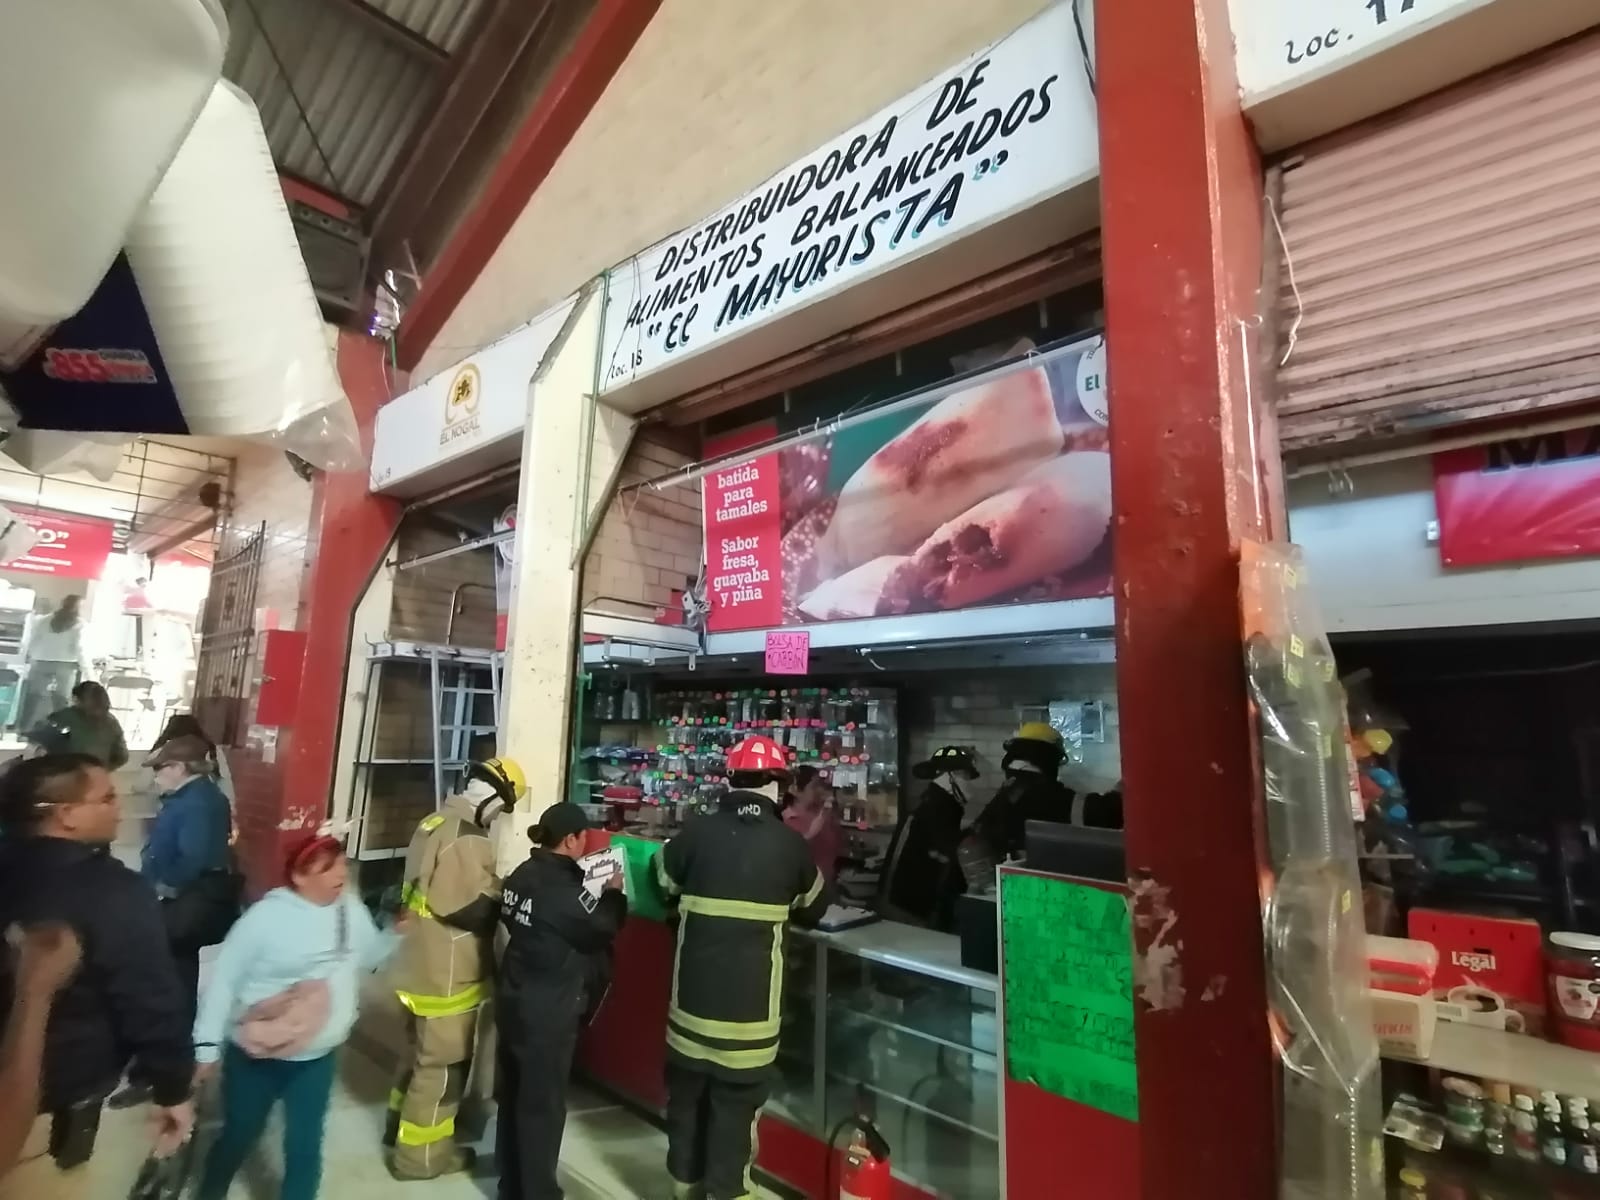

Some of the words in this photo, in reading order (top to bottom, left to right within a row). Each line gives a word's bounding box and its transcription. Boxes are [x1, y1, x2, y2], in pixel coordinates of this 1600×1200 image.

[1365, 0, 1415, 25] 1
[655, 115, 898, 282] DISTRIBUIDORA
[926, 59, 991, 131] DE
[626, 233, 766, 329] ALIMENTOS
[790, 74, 1059, 246] BALANCEADOS
[451, 417, 480, 440] NOGAL
[717, 467, 760, 489] batida
[723, 486, 754, 507] para
[716, 500, 768, 522] tamales
[721, 536, 759, 554] Sabor
[722, 553, 759, 570] fresa,
[713, 568, 770, 592] guayaba
[720, 592, 730, 608] y
[731, 587, 763, 607] piña
[1451, 951, 1496, 972] Legal
